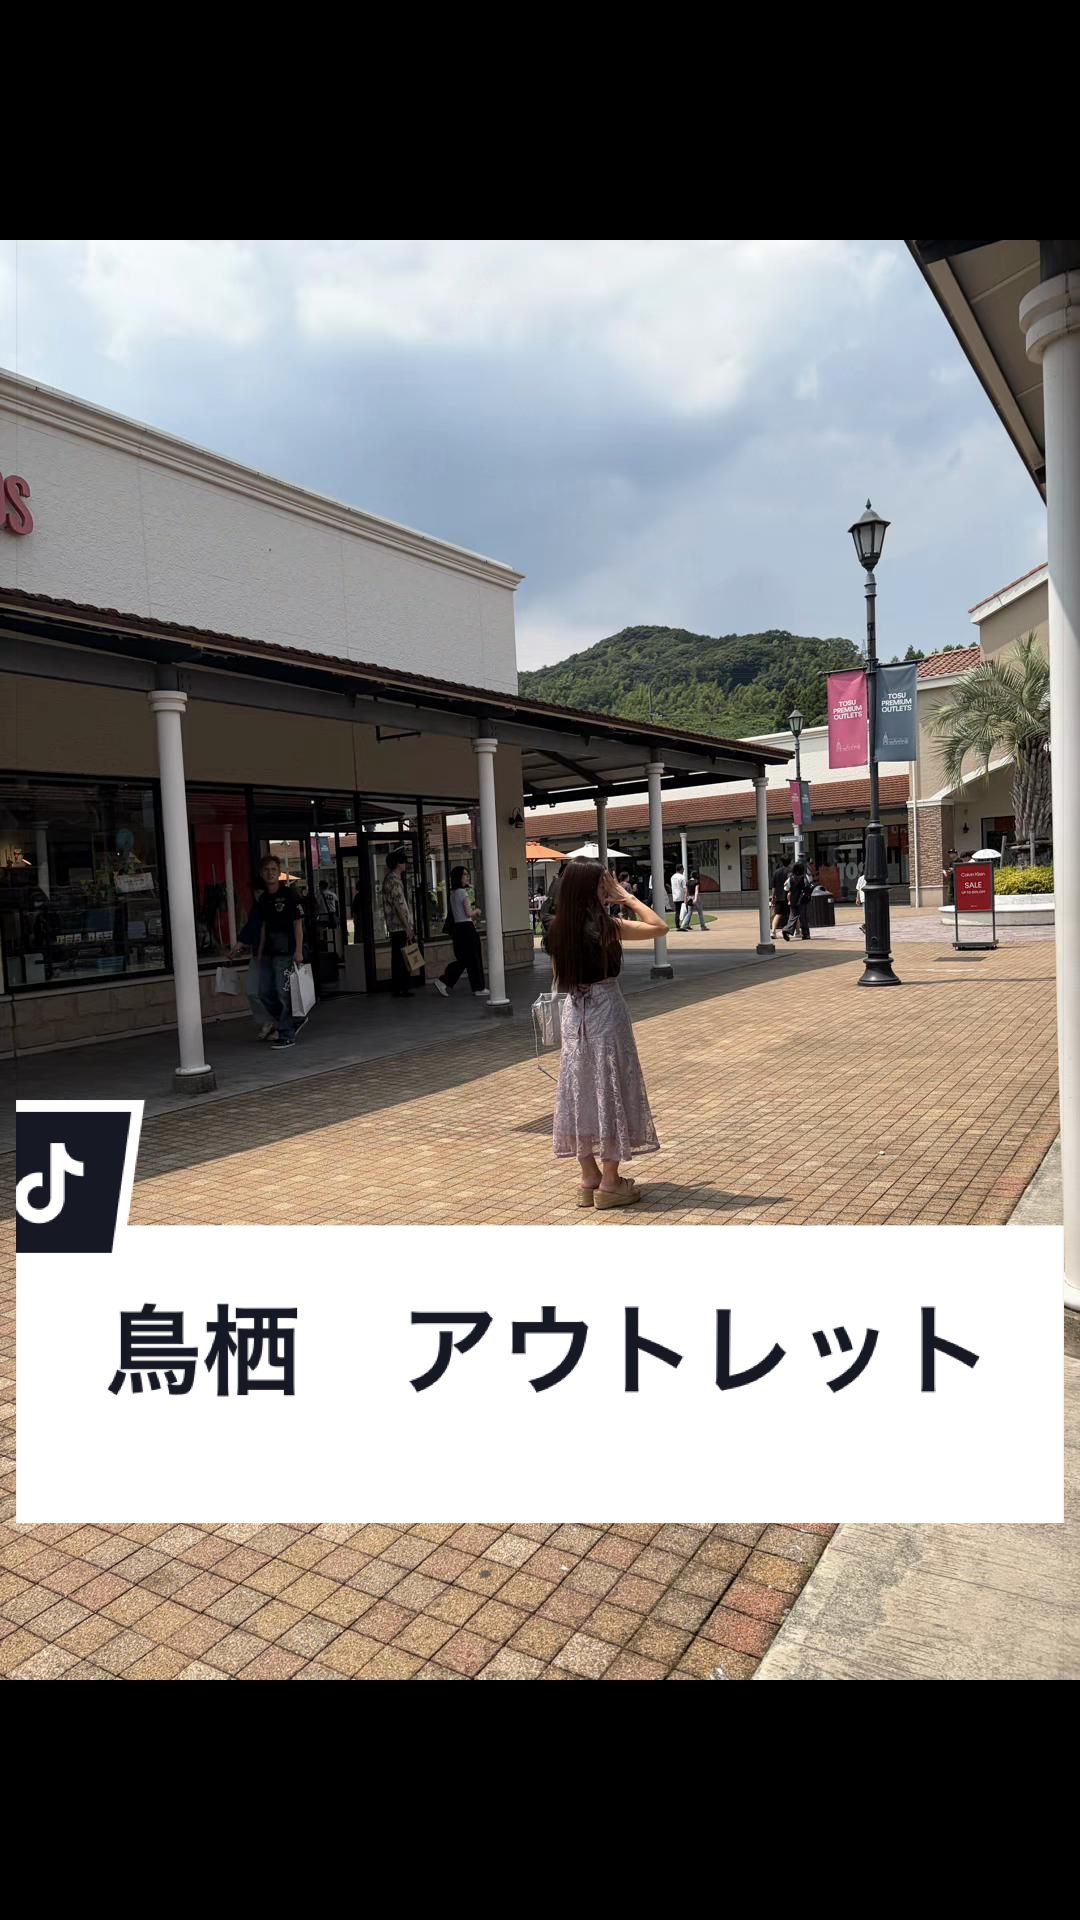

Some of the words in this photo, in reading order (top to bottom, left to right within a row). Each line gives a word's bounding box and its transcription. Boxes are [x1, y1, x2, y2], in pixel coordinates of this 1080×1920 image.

[0, 472, 33, 535] S
[887, 692, 906, 700] TOSU
[838, 699, 856, 707] TOSU
[881, 698, 912, 706] PREMIUM
[833, 705, 863, 714] PREMIUM
[881, 704, 912, 713] OUTLETS
[833, 711, 863, 720] OUTLETS
[964, 881, 982, 889] SALE
